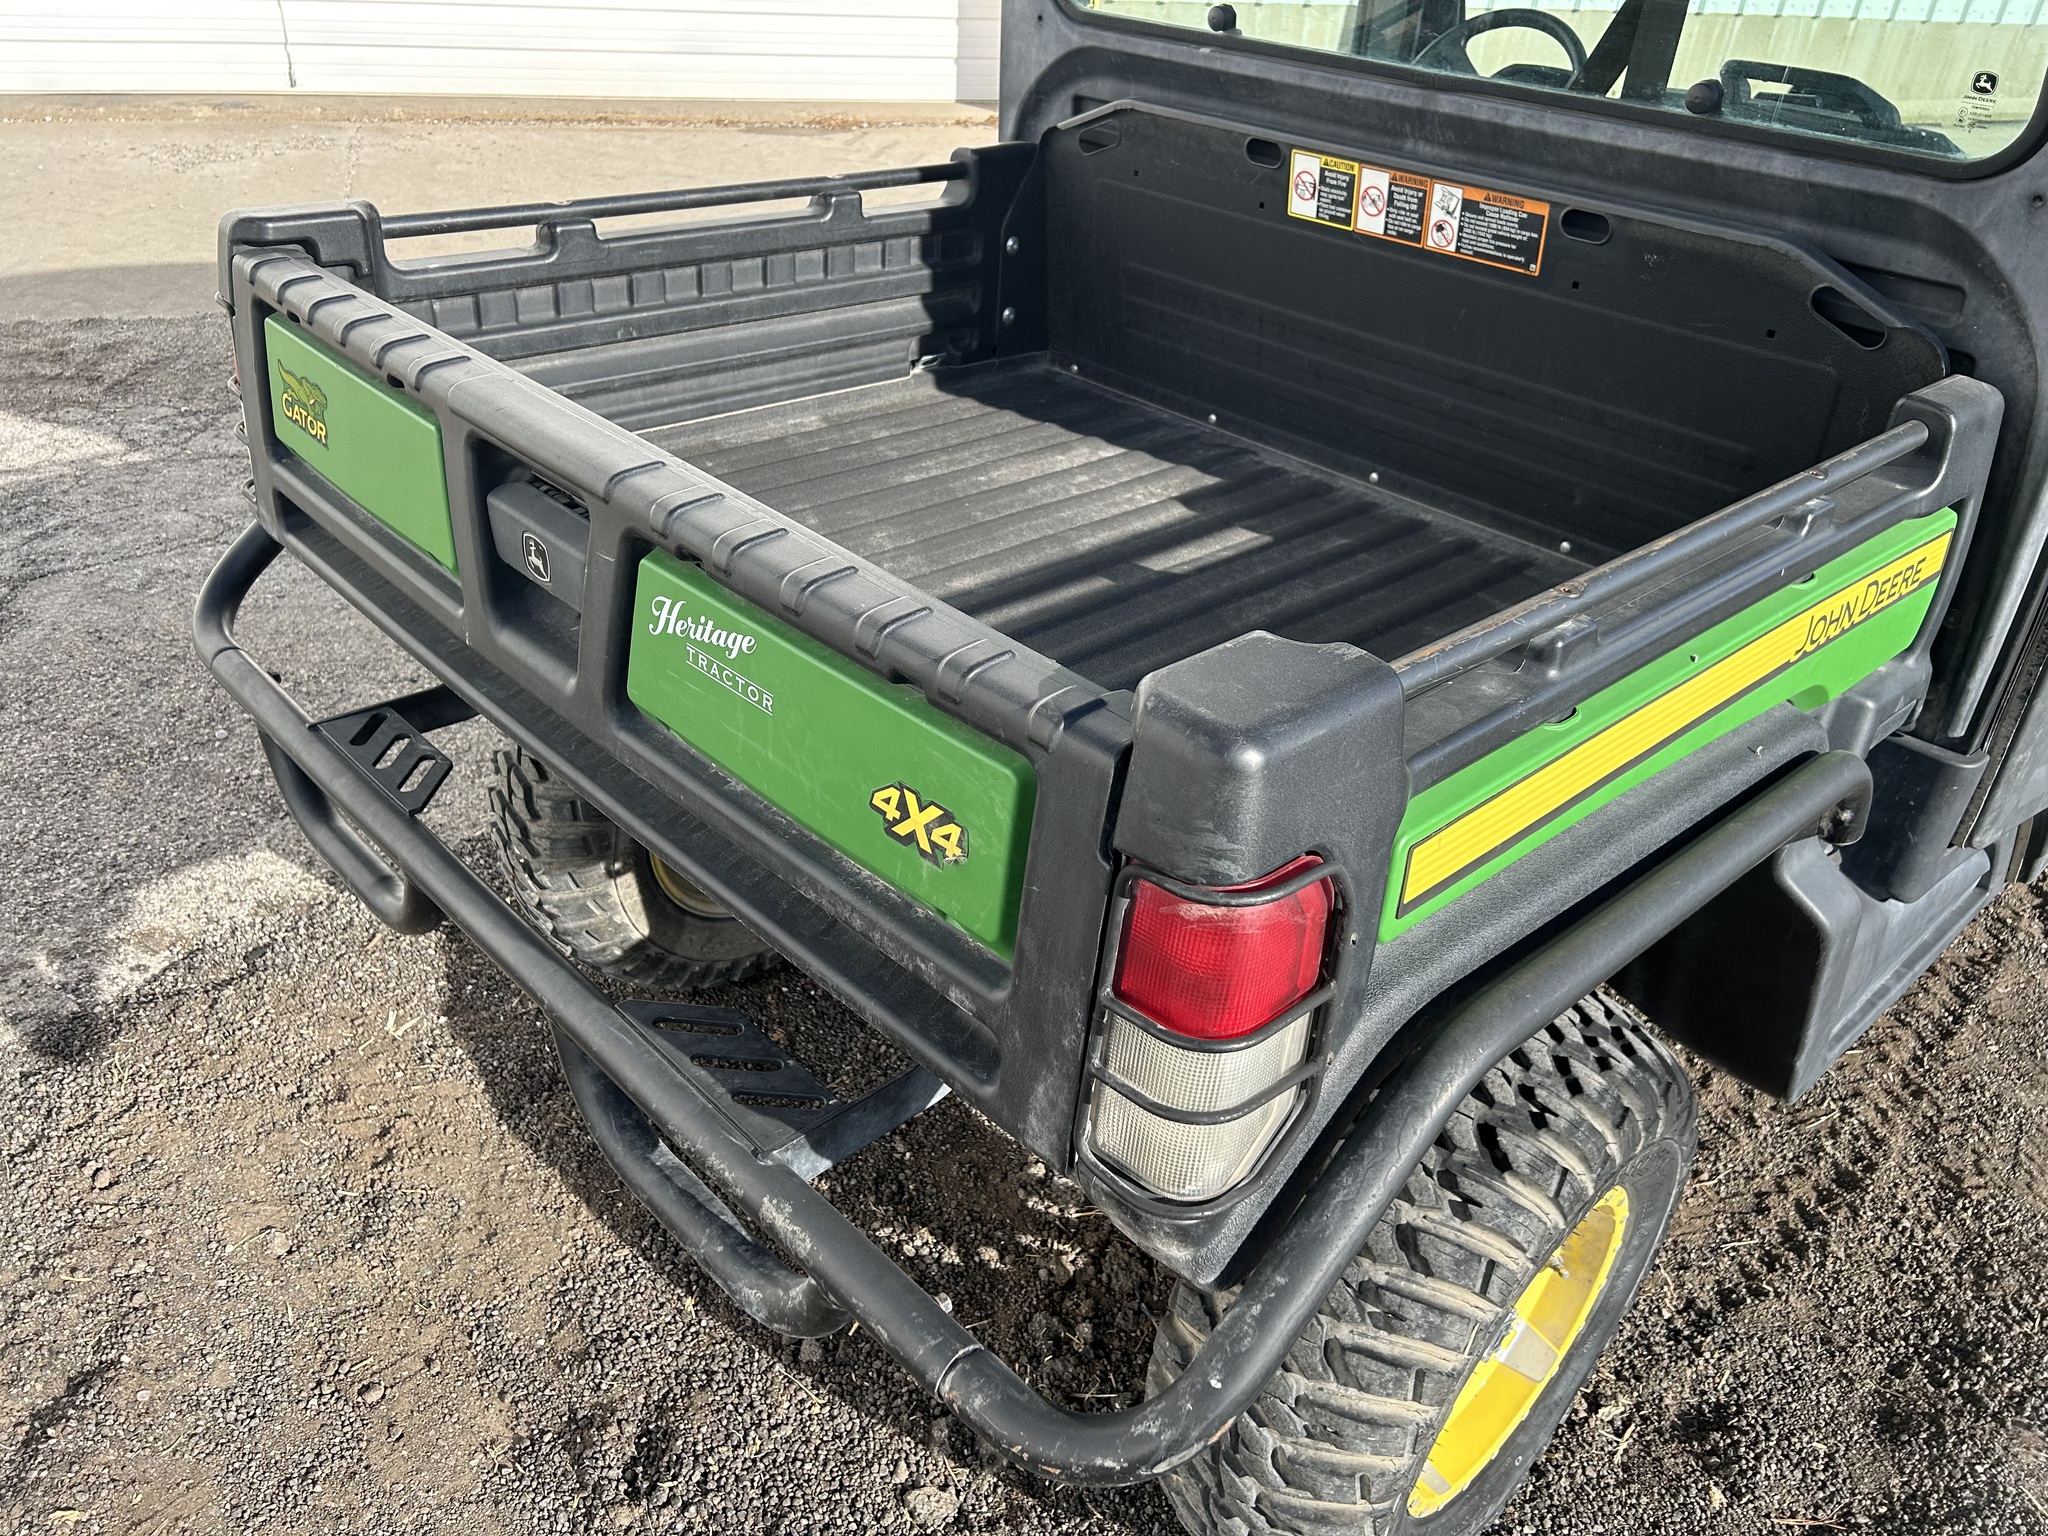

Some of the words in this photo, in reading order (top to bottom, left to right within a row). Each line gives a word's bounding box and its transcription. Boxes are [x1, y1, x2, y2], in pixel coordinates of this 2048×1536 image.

[1330, 160, 1354, 171] CAUTION
[1324, 170, 1336, 178] Avoid
[1337, 173, 1349, 182] Injury
[1326, 177, 1337, 185] From
[1338, 180, 1347, 188] Fire
[1399, 174, 1428, 188] WARNING
[1391, 185, 1403, 193] Avoid
[1404, 187, 1417, 197] Injury
[1393, 192, 1406, 201] Death
[1394, 200, 1409, 210] Falling
[1492, 193, 1525, 209] WARNING
[1479, 202, 1499, 212] Improper
[1500, 207, 1518, 217] Loading
[1486, 210, 1499, 218] Cause
[1500, 213, 1520, 222] Rollover
[282, 392, 327, 444] GATOR
[1793, 595, 1859, 656] JOHN
[1859, 557, 1927, 618] DEERE
[648, 595, 758, 659] Heritage
[686, 645, 774, 713] TRACTOR
